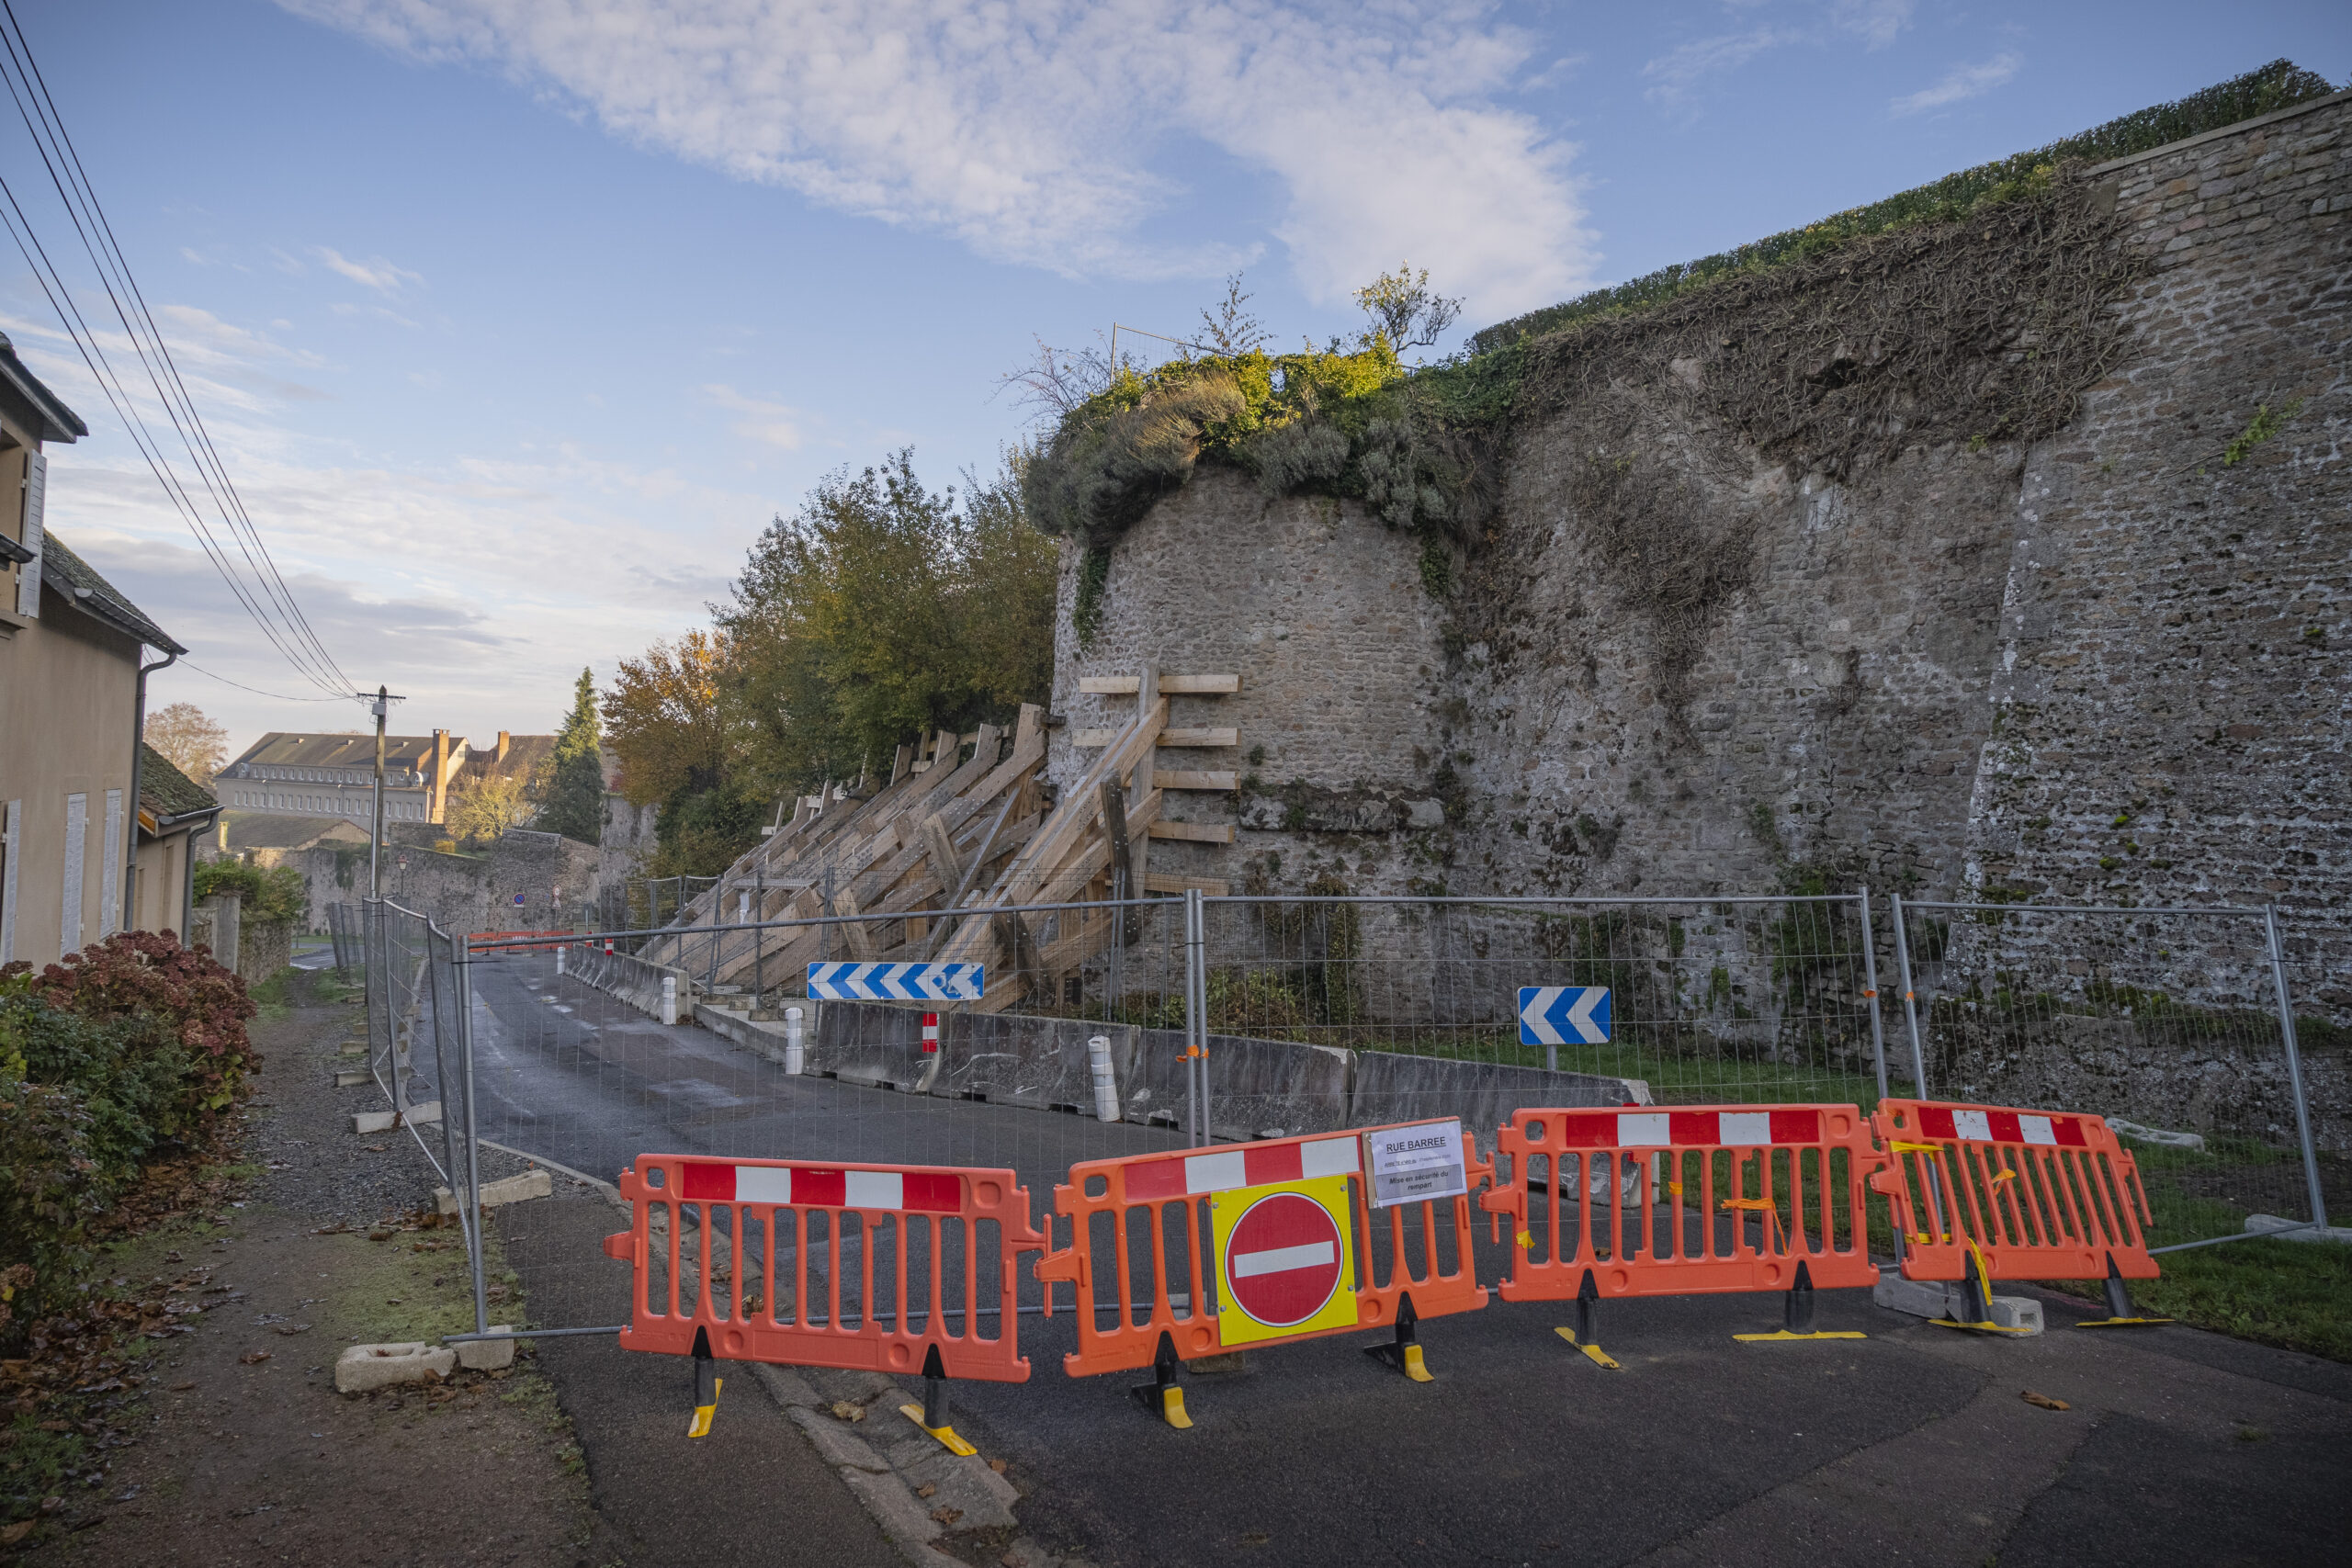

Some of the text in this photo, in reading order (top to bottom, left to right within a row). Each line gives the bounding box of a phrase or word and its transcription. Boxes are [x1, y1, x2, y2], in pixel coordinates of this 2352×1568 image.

[1386, 1136, 1446, 1152] RUE BARREE
[1415, 1171, 1439, 1181] sécurité
[1408, 1181, 1432, 1190] rempart
